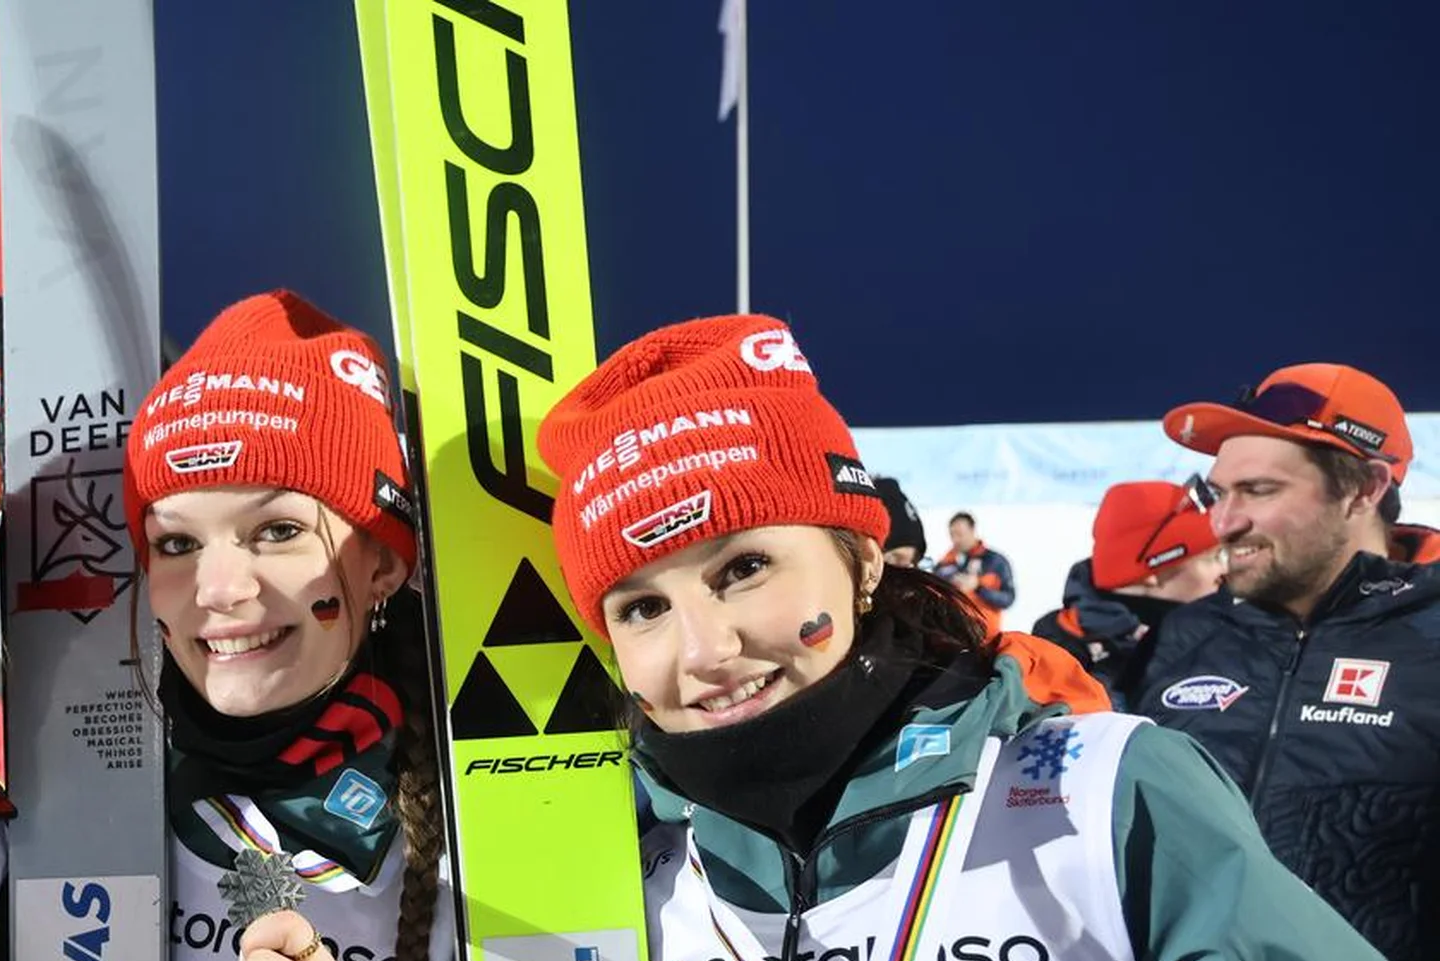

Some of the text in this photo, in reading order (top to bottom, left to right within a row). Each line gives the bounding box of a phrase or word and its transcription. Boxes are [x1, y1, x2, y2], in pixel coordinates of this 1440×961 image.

[432, 0, 555, 527] FISC
[40, 388, 126, 424] VAN
[144, 409, 299, 450] Wärmepumpen
[580, 445, 758, 530] Wärmepumpen
[105, 690, 142, 700] WHEN
[65, 701, 142, 714] PERFECTION
[84, 712, 142, 725] BECOMES
[1300, 706, 1394, 727] Kaufland
[72, 724, 142, 737] OBSESSION
[87, 736, 143, 747] MAGICAL
[97, 747, 142, 759] THINGS
[107, 759, 142, 769] ARISE
[465, 750, 624, 776] FISCHER
